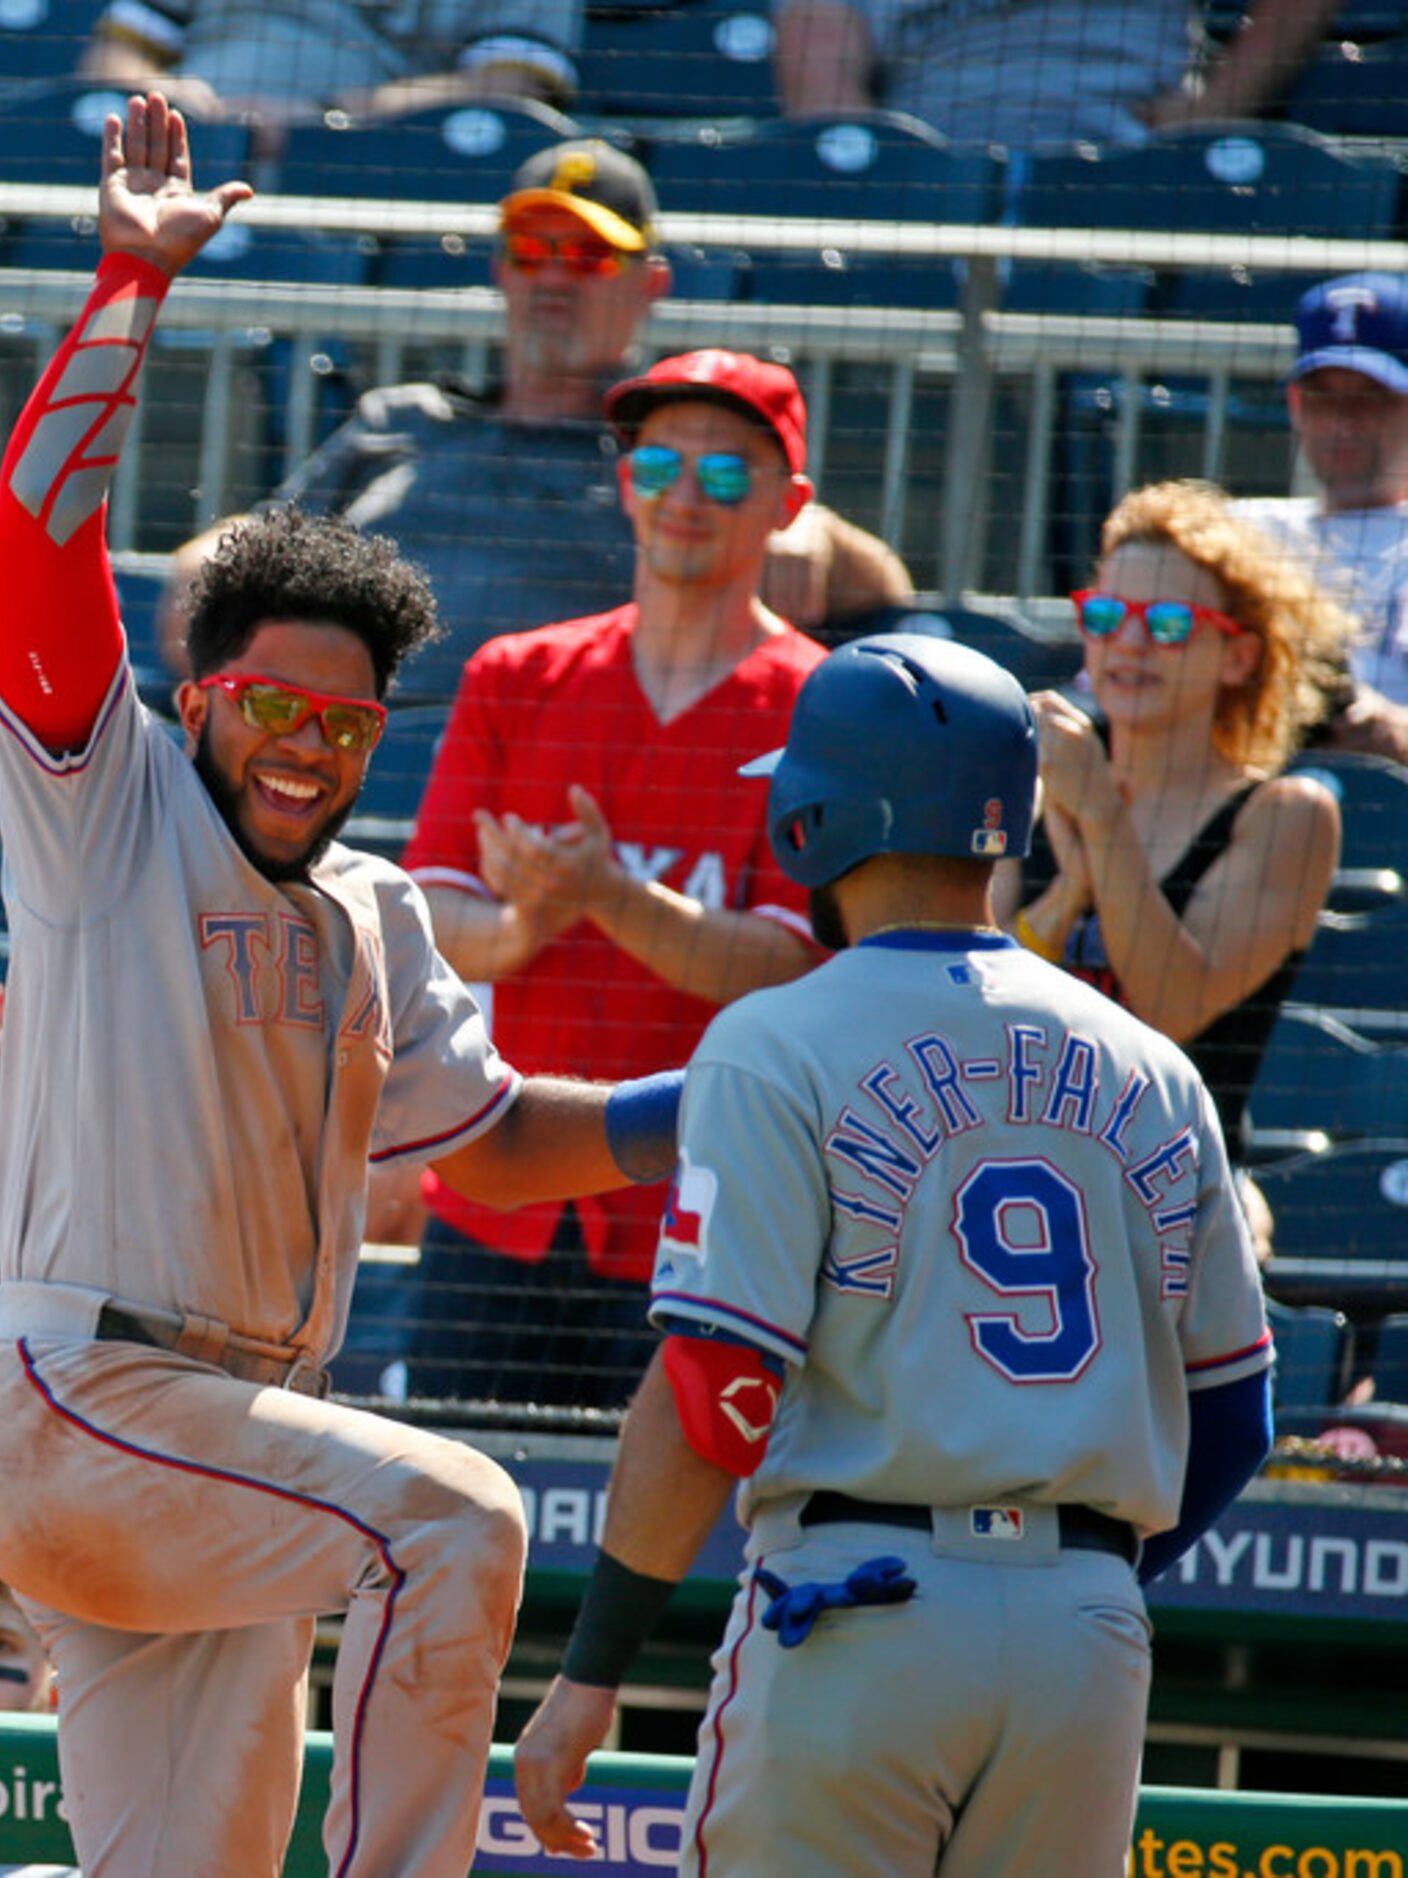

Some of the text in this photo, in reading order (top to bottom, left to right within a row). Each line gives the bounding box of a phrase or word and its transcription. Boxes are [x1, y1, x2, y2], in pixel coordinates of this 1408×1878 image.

[1327, 287, 1379, 340] T
[983, 797, 1003, 830] 9
[949, 1156, 1104, 1386] 9
[1127, 1828, 1403, 1878] tes.com
